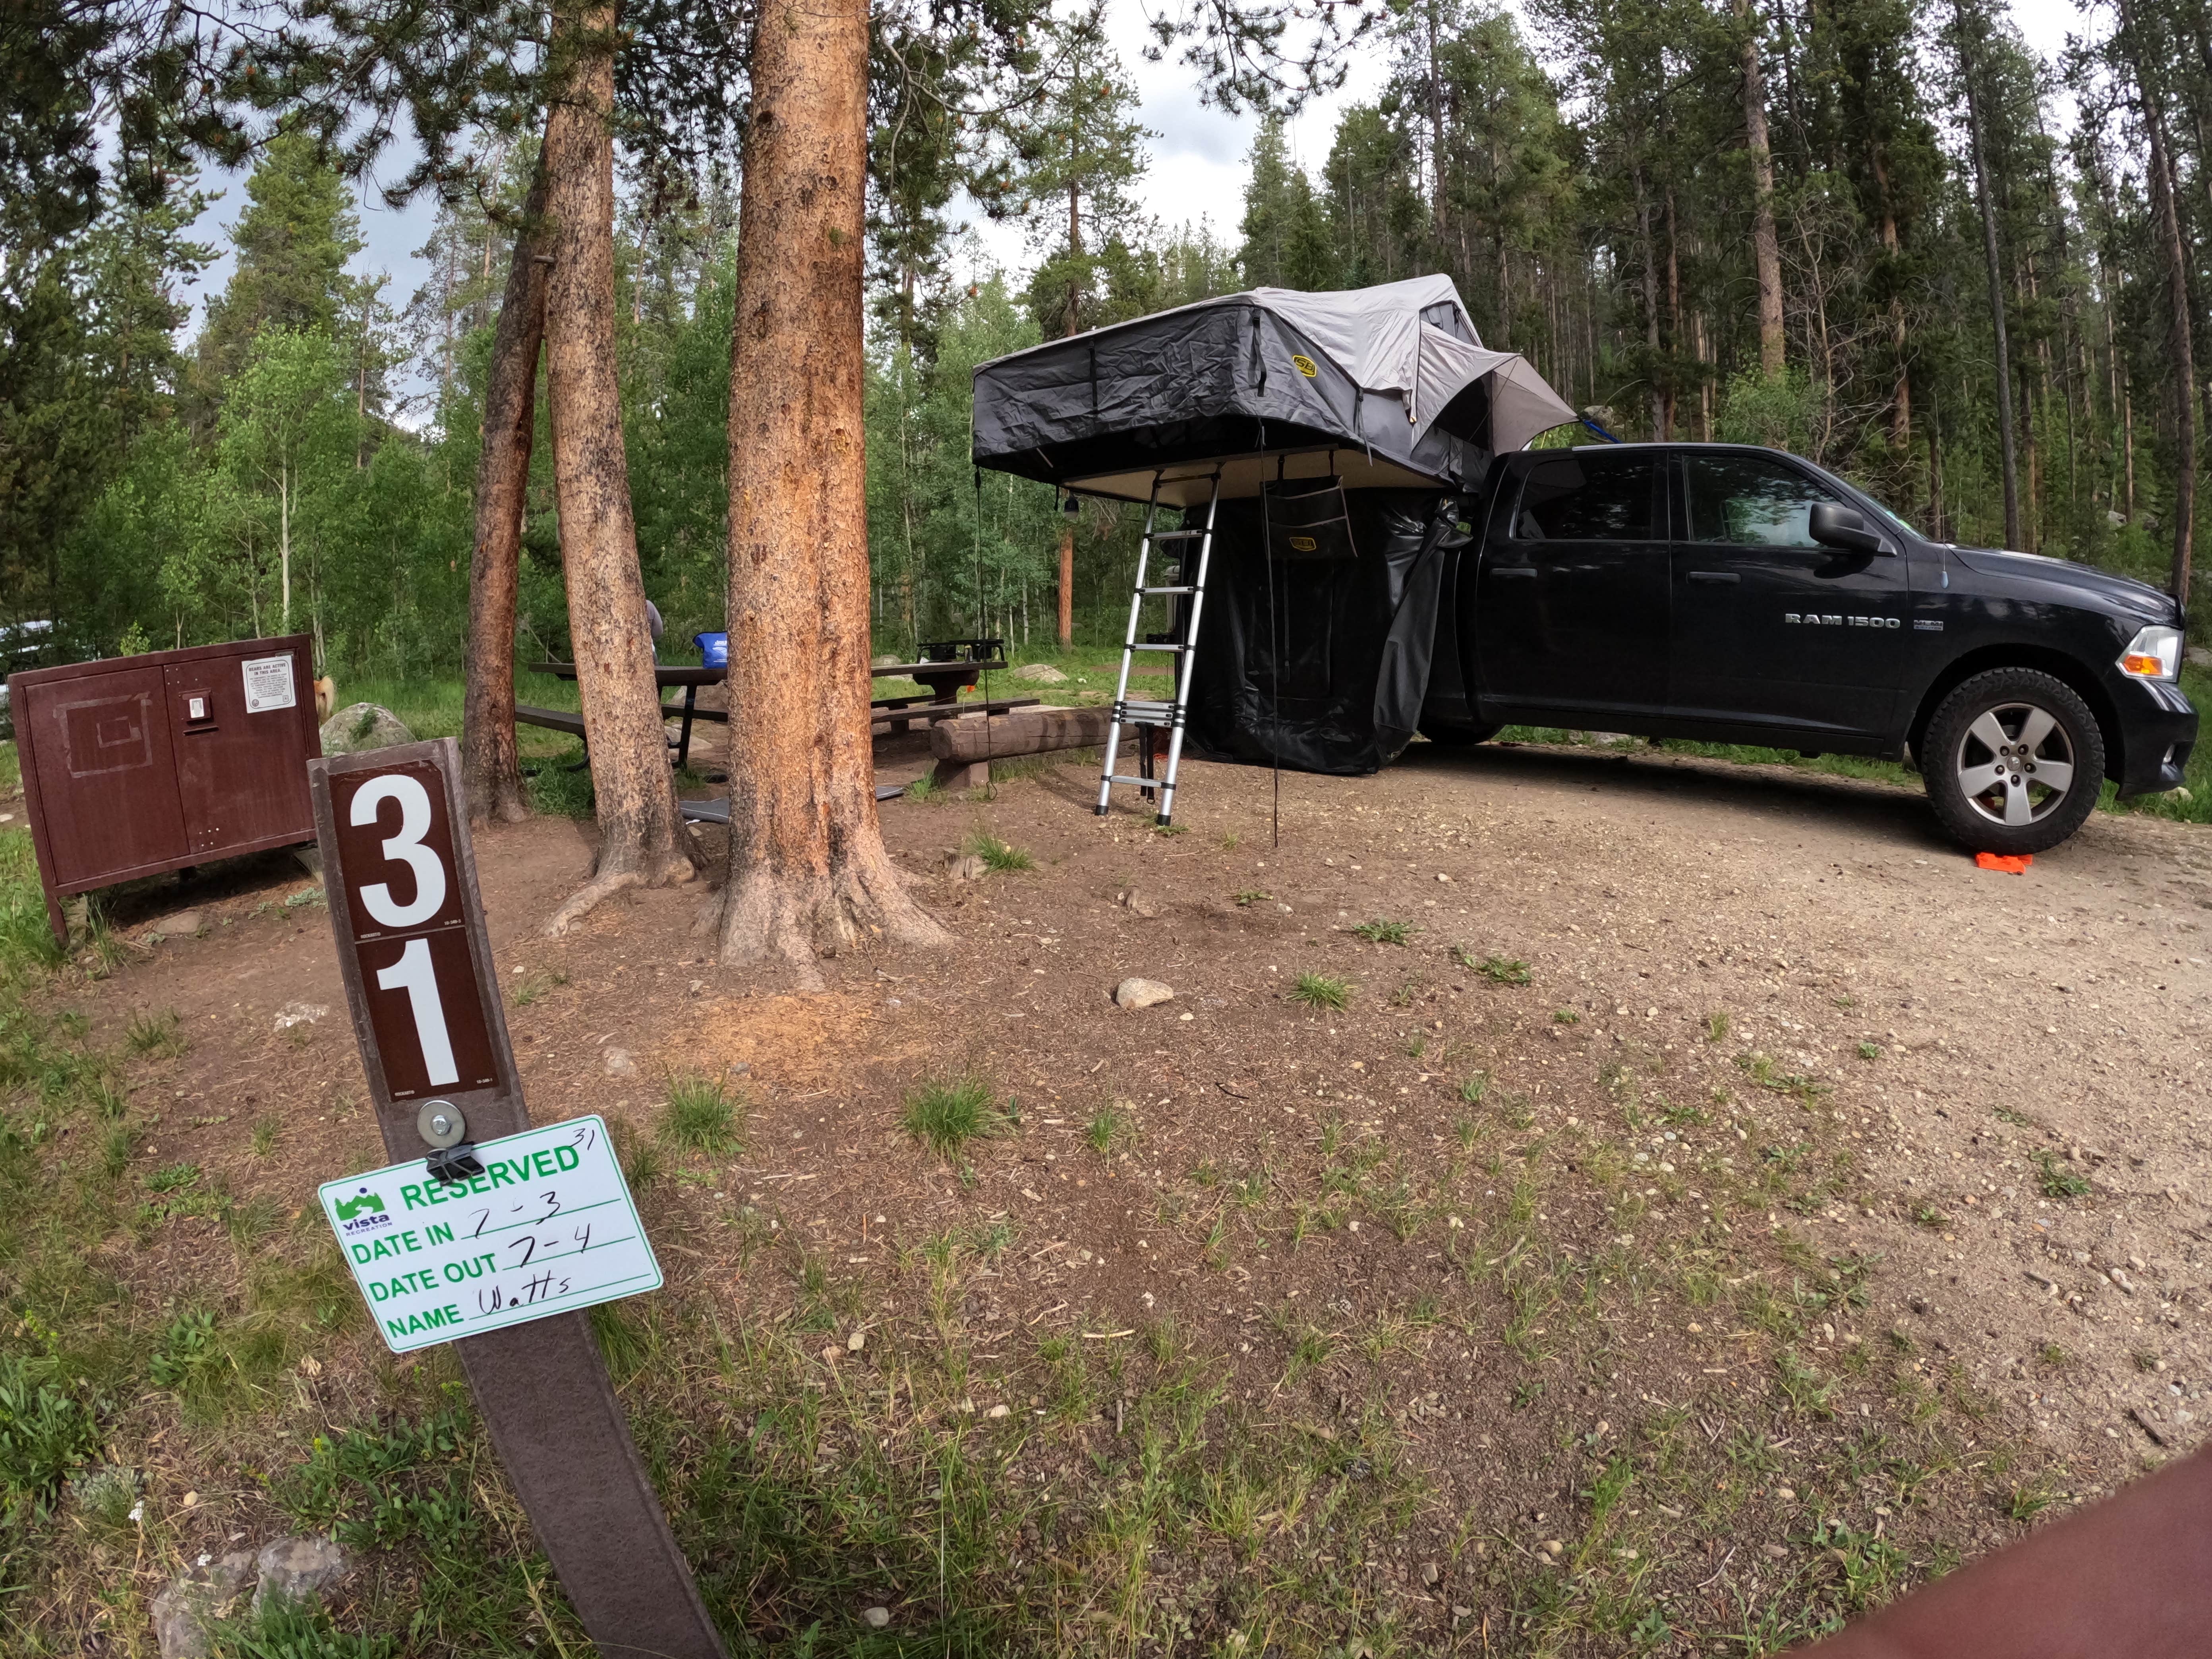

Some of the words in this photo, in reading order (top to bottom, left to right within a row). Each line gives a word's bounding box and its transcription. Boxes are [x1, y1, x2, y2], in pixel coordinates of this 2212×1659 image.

[1785, 613, 1842, 625] RAM
[1847, 616, 1901, 629] 1500
[568, 1127, 595, 1150] 31
[400, 1145, 580, 1210] RESERVED
[342, 1214, 390, 1230] vista
[346, 1222, 393, 1236] RECREATION
[351, 1230, 423, 1265] DATE
[425, 1222, 455, 1246] IN
[369, 1268, 439, 1302] DATE
[444, 1253, 497, 1283] OUT
[478, 1270, 572, 1315] Watts
[387, 1303, 464, 1338] NAME
